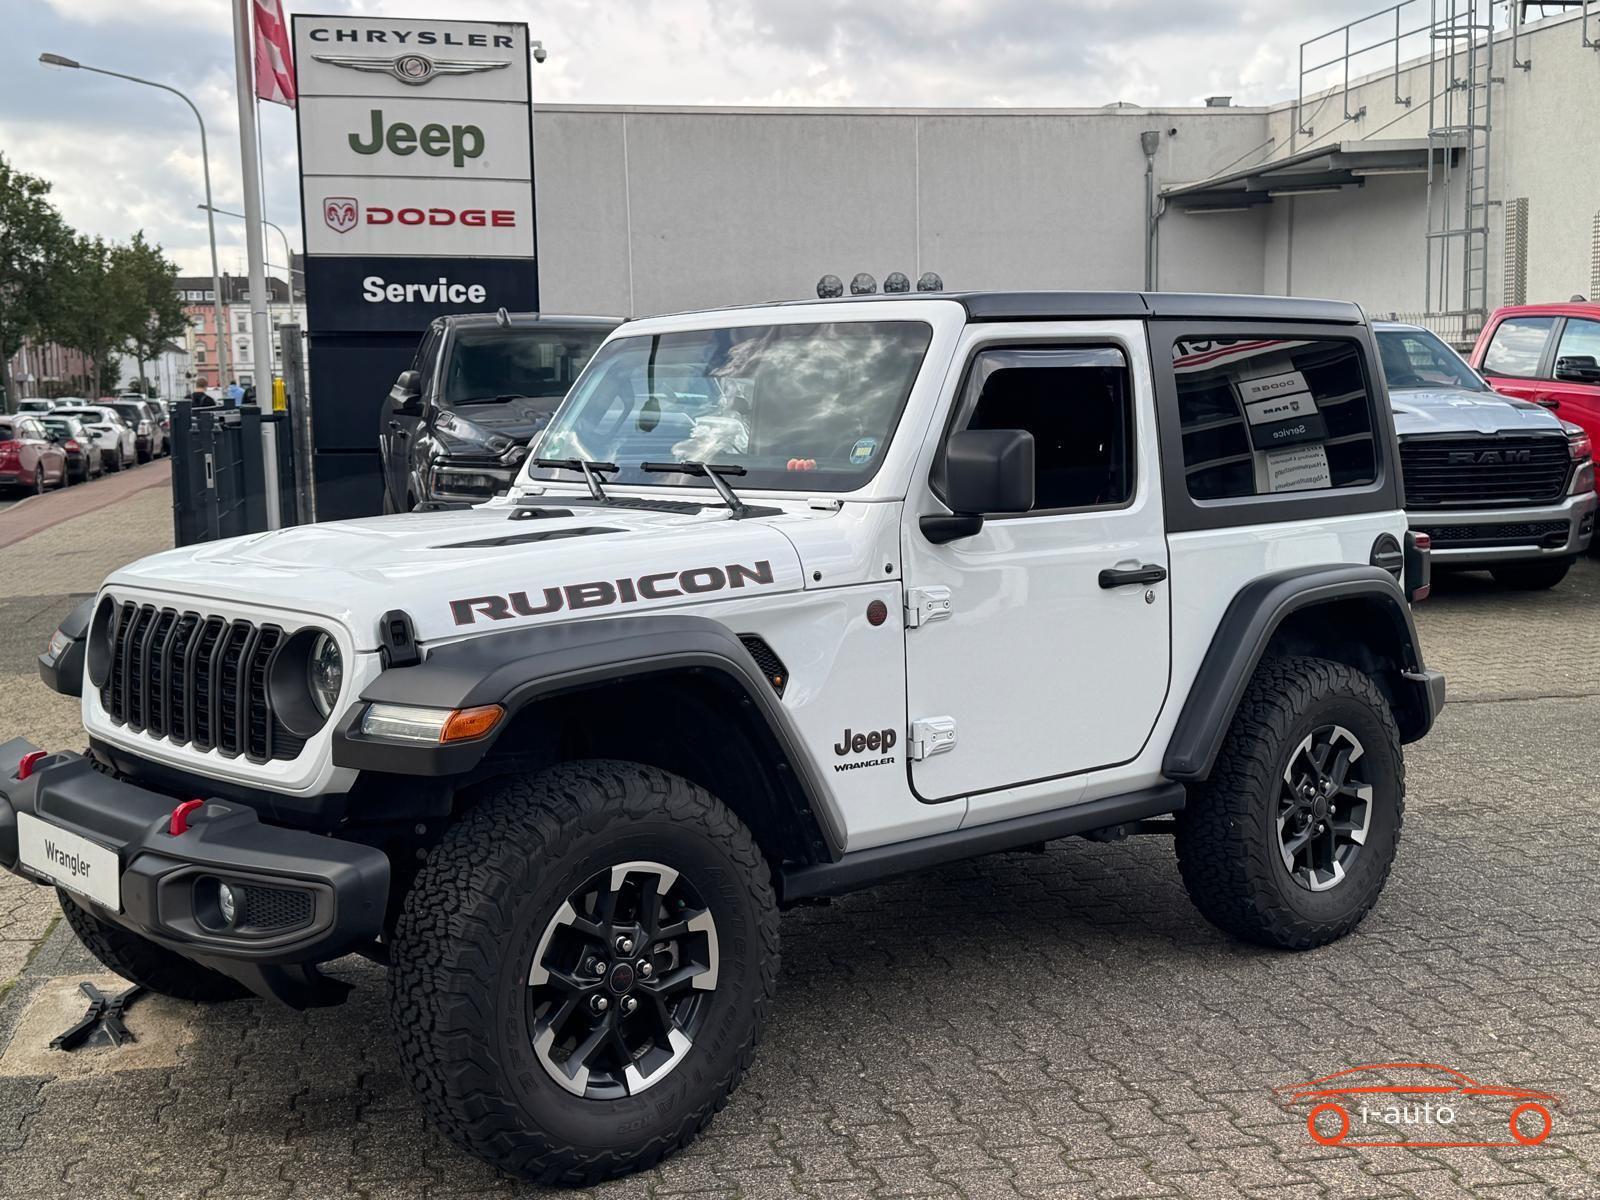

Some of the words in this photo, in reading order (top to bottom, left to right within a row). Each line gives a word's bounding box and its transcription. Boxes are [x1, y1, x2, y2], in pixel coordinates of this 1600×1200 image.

[309, 28, 515, 49] CHRYSLER
[348, 109, 485, 168] Jeep
[366, 207, 517, 228] DODGE
[362, 276, 487, 304] Service
[1447, 449, 1531, 465] RAM
[449, 560, 775, 626] RUBICON
[833, 728, 897, 757] Jeep
[834, 757, 896, 773] WRANGLER
[44, 838, 91, 878] Wrangler
